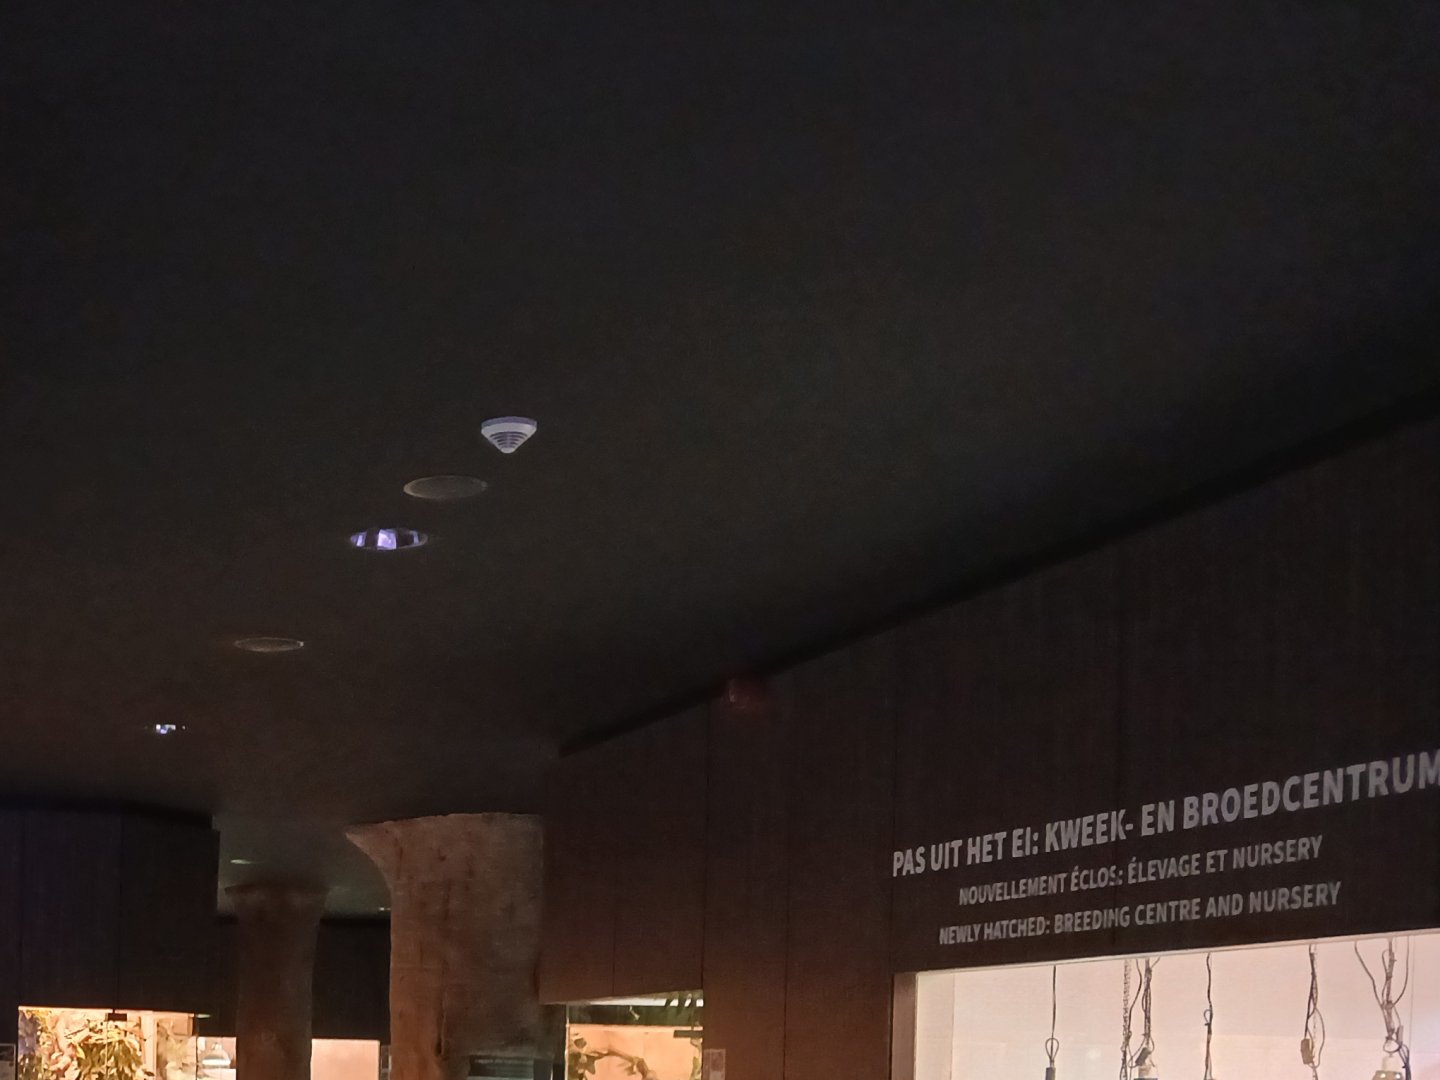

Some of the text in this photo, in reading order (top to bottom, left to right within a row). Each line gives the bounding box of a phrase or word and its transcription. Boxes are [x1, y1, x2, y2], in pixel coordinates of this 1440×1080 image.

[892, 748, 1440, 877] PAS UIT HET EI: KWEEK- EN BROEDCENTRUM
[959, 834, 1323, 906] NOUVELLEMENT ÉCLOS: ÉLEVAGE ET NURSERY
[939, 880, 1342, 945] NEWLY HATCHED: BREEDING CENTRE AND NURSERY
